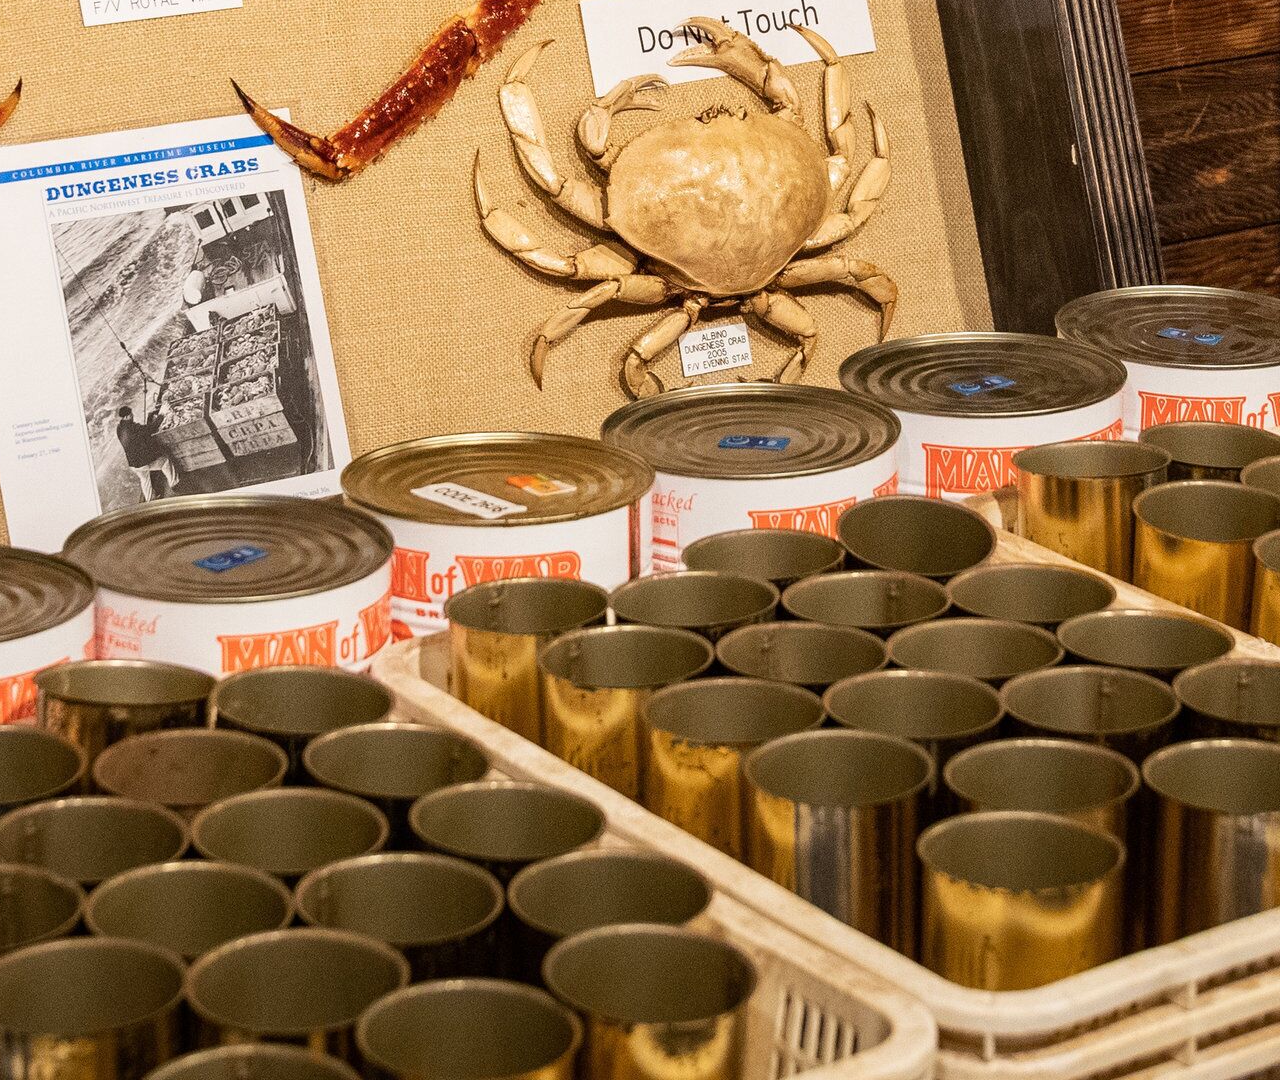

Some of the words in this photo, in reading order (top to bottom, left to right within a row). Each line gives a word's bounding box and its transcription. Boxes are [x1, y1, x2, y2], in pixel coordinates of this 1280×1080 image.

[93, 0, 121, 15] F/V
[637, 26, 674, 53] Do
[12, 163, 76, 180] COLUMBIA
[81, 157, 117, 171] RIVER
[124, 149, 183, 165] MARITIME
[189, 141, 237, 154] MUSEUM
[45, 168, 180, 202] DUNGENESS
[185, 157, 260, 181] CRABS
[685, 340, 725, 354] DUNGENESS
[728, 335, 746, 346] CRAB
[701, 330, 727, 342] ALBINO
[703, 357, 730, 370] EVENING
[732, 353, 749, 363] STAR
[707, 348, 727, 359] 2005
[1138, 391, 1247, 431] MAN
[1246, 404, 1268, 431] of
[652, 489, 698, 513] acked
[654, 515, 676, 526] acts
[431, 566, 457, 599] of
[216, 620, 339, 673] MAN
[340, 623, 359, 662] of
